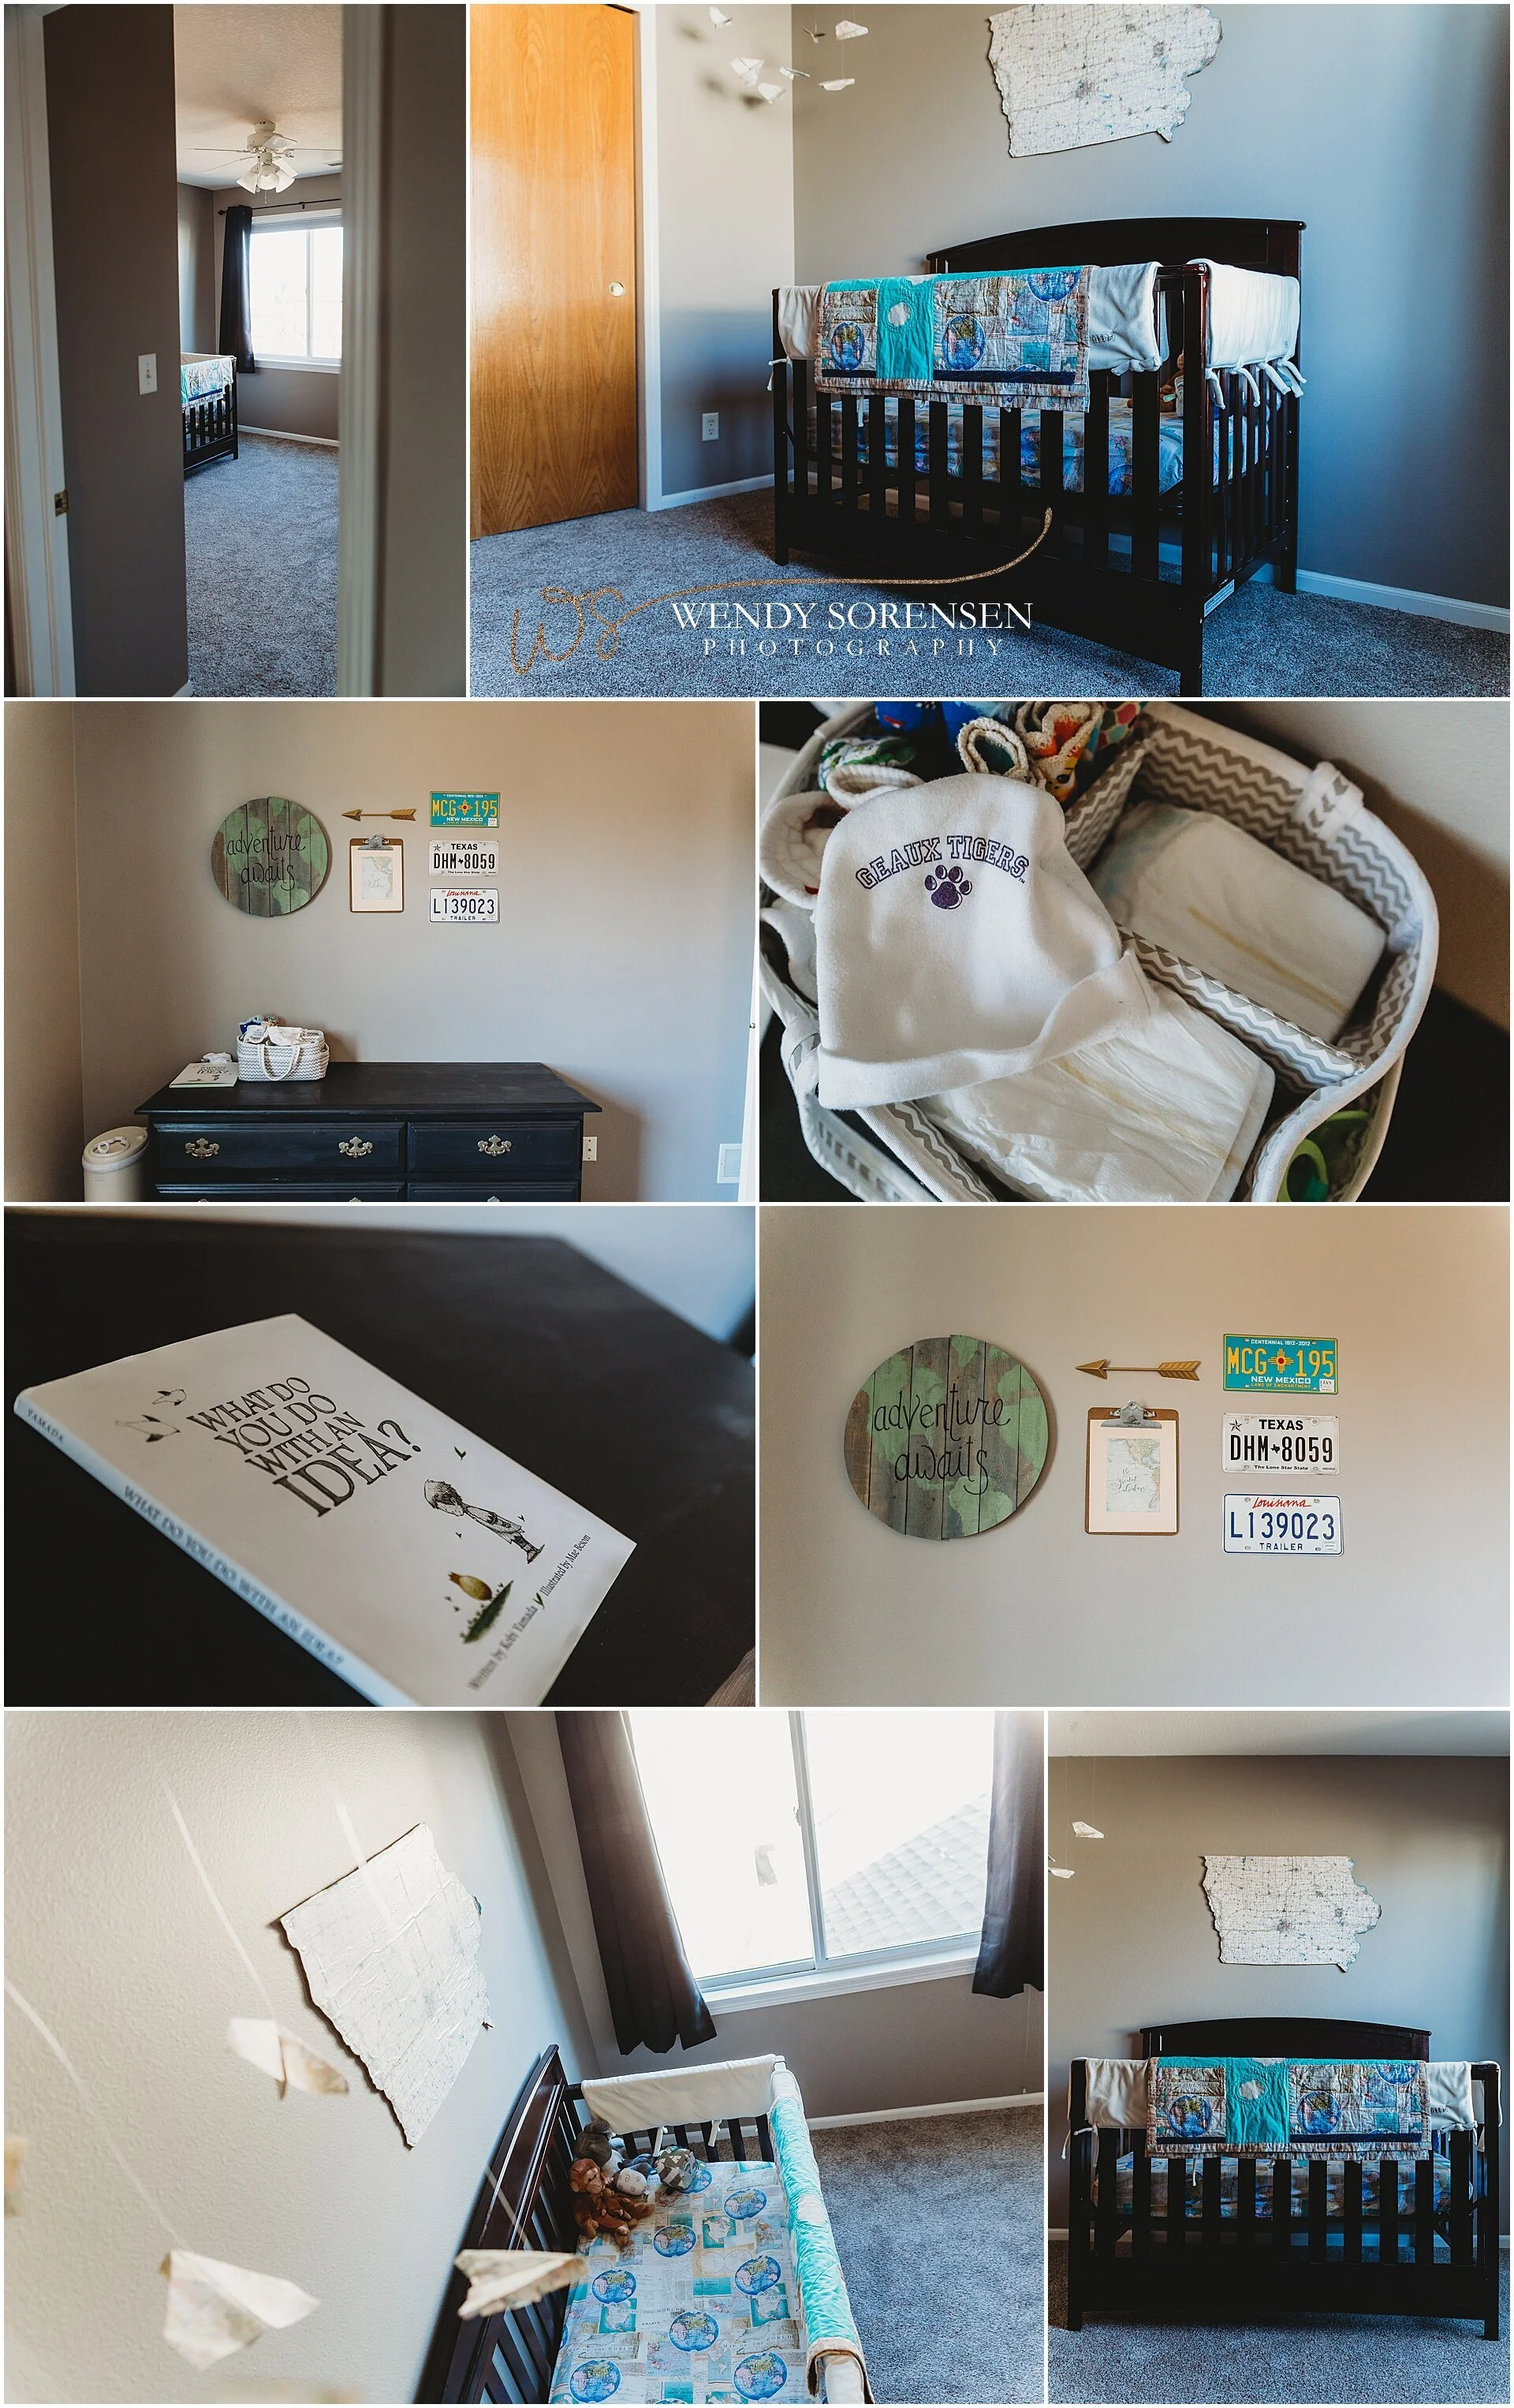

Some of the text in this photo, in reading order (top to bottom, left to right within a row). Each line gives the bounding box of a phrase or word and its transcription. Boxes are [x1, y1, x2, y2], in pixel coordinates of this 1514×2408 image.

[432, 799, 498, 818] MCG 195
[227, 826, 306, 861] adventure
[434, 853, 495, 869] DHM 8059
[241, 857, 296, 891] awaits
[855, 837, 942, 890] GEAUX
[946, 835, 1029, 879] TIGERS
[434, 898, 494, 914] L139023
[1227, 1347, 1334, 1378] MCG 195
[186, 1377, 310, 1432] WHAT DO
[871, 1383, 1011, 1442] adventure
[27, 1408, 64, 1443] YAMADA
[214, 1394, 337, 1455] YOU DO
[1259, 1419, 1303, 1431] TEXAS
[244, 1411, 366, 1477] WITH AN
[1230, 1434, 1333, 1463] DHM 8059
[272, 1420, 422, 1518] IDEA?
[893, 1435, 989, 1495] awaits
[1252, 1497, 1312, 1509] Louisiana
[125, 1484, 161, 1521] WHAT
[161, 1517, 185, 1539] DO
[185, 1534, 215, 1562] YOU
[213, 1558, 237, 1581] DO
[1231, 1511, 1335, 1540] L139023
[539, 1533, 591, 1597] Illustrated by Mae Besom
[512, 1604, 539, 1633] Yamada
